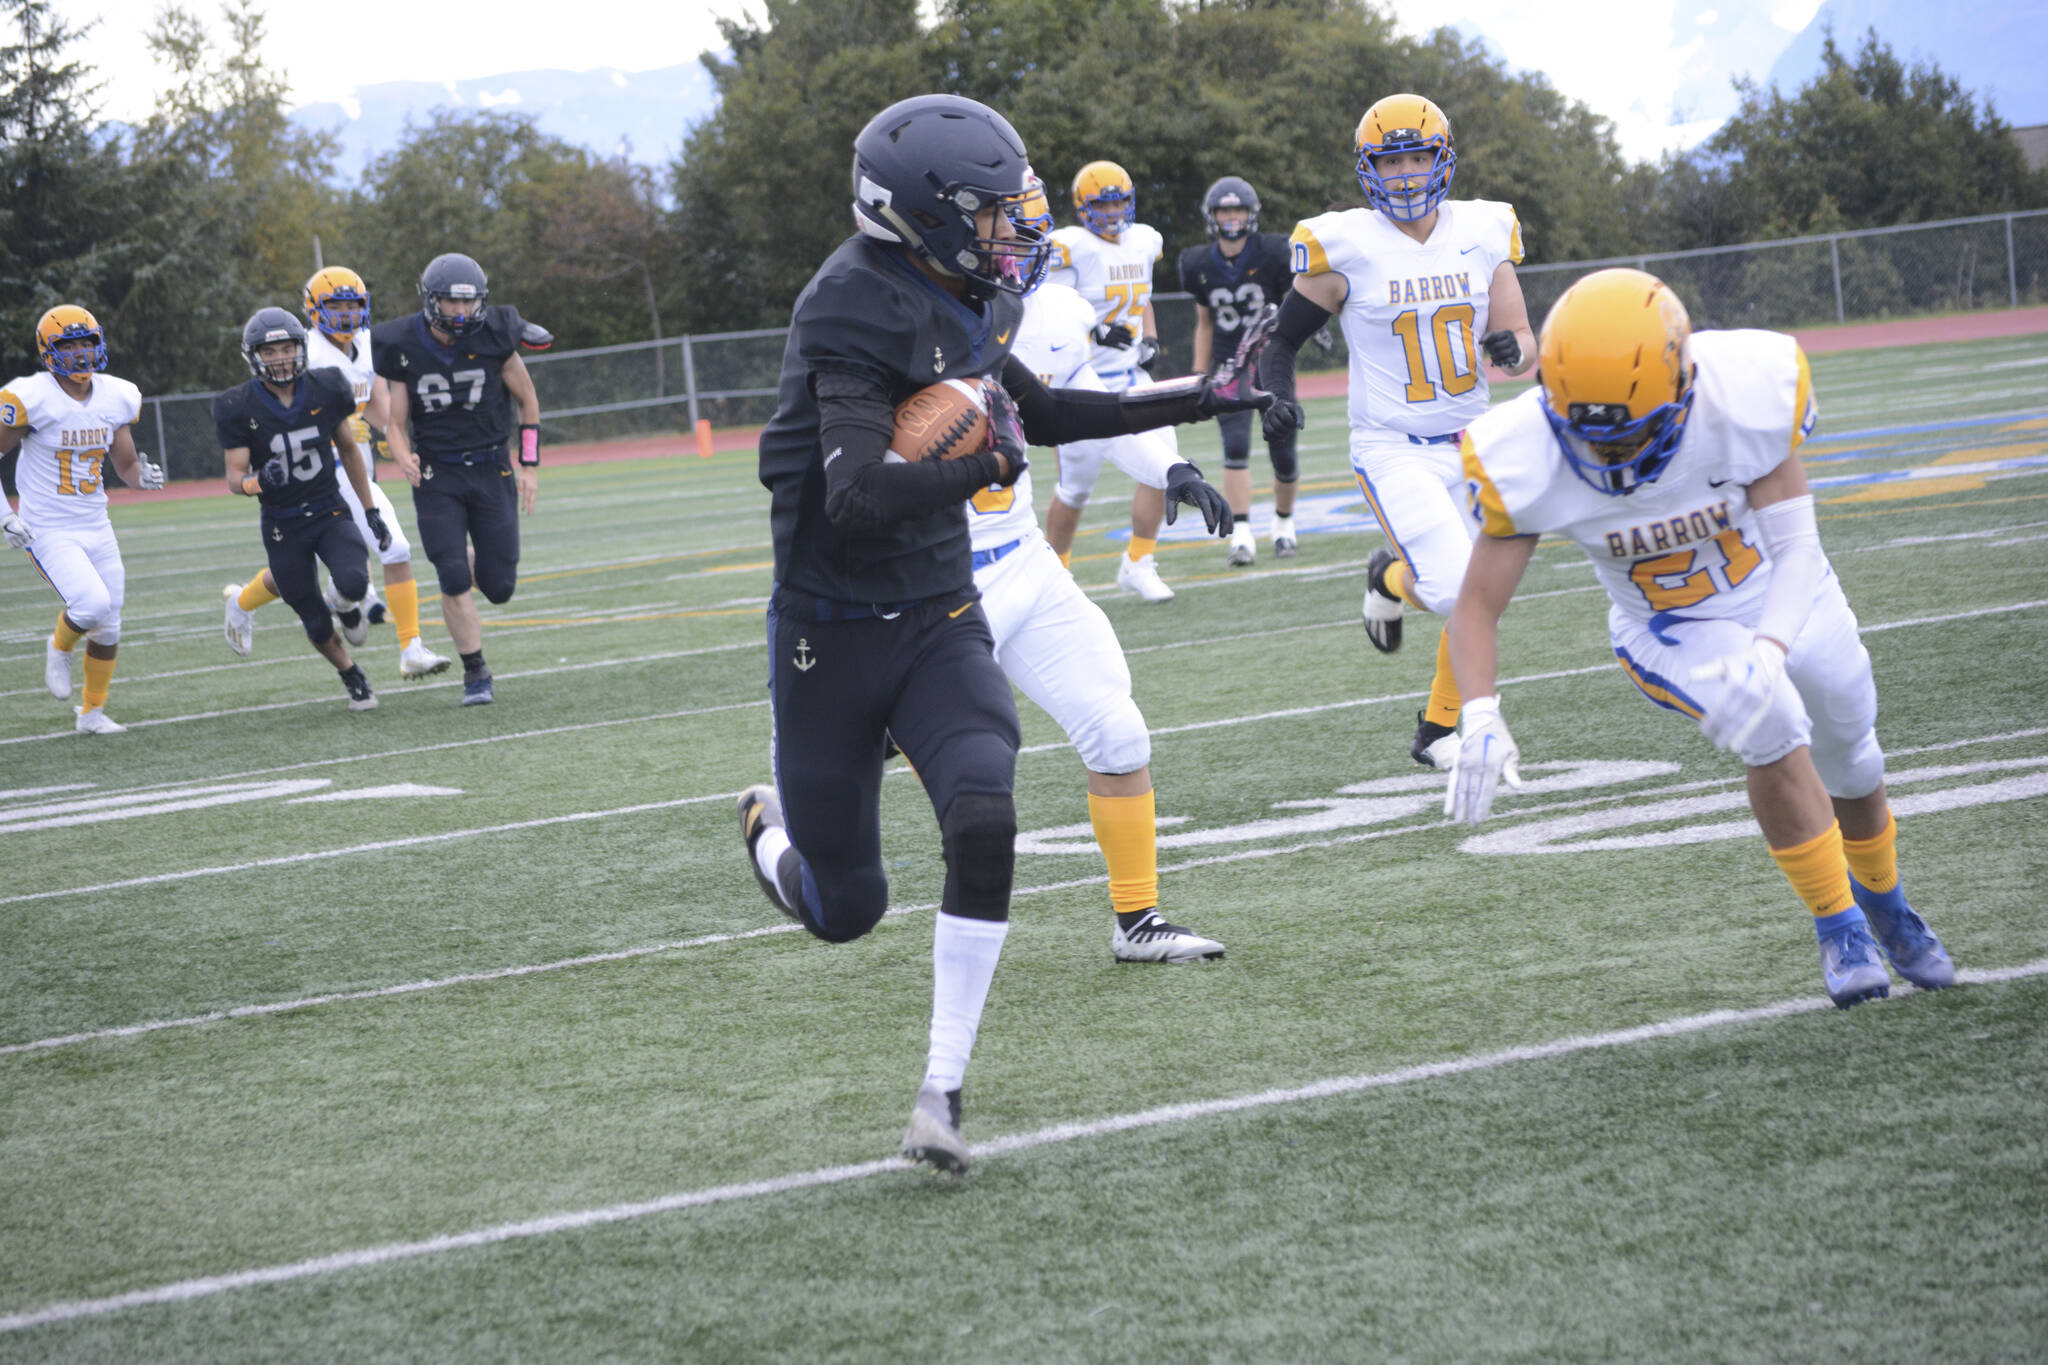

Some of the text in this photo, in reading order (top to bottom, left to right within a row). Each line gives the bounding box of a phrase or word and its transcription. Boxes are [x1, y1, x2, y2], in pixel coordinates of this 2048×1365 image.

[1103, 282, 1150, 340] 75
[1209, 282, 1265, 331] 63
[1389, 271, 1472, 305] BARROW
[1391, 302, 1479, 404] 10
[417, 367, 487, 415] 67
[55, 448, 107, 495] 13
[269, 425, 324, 485] 15
[1605, 500, 1732, 559] BARROW
[1628, 526, 1765, 614] 21
